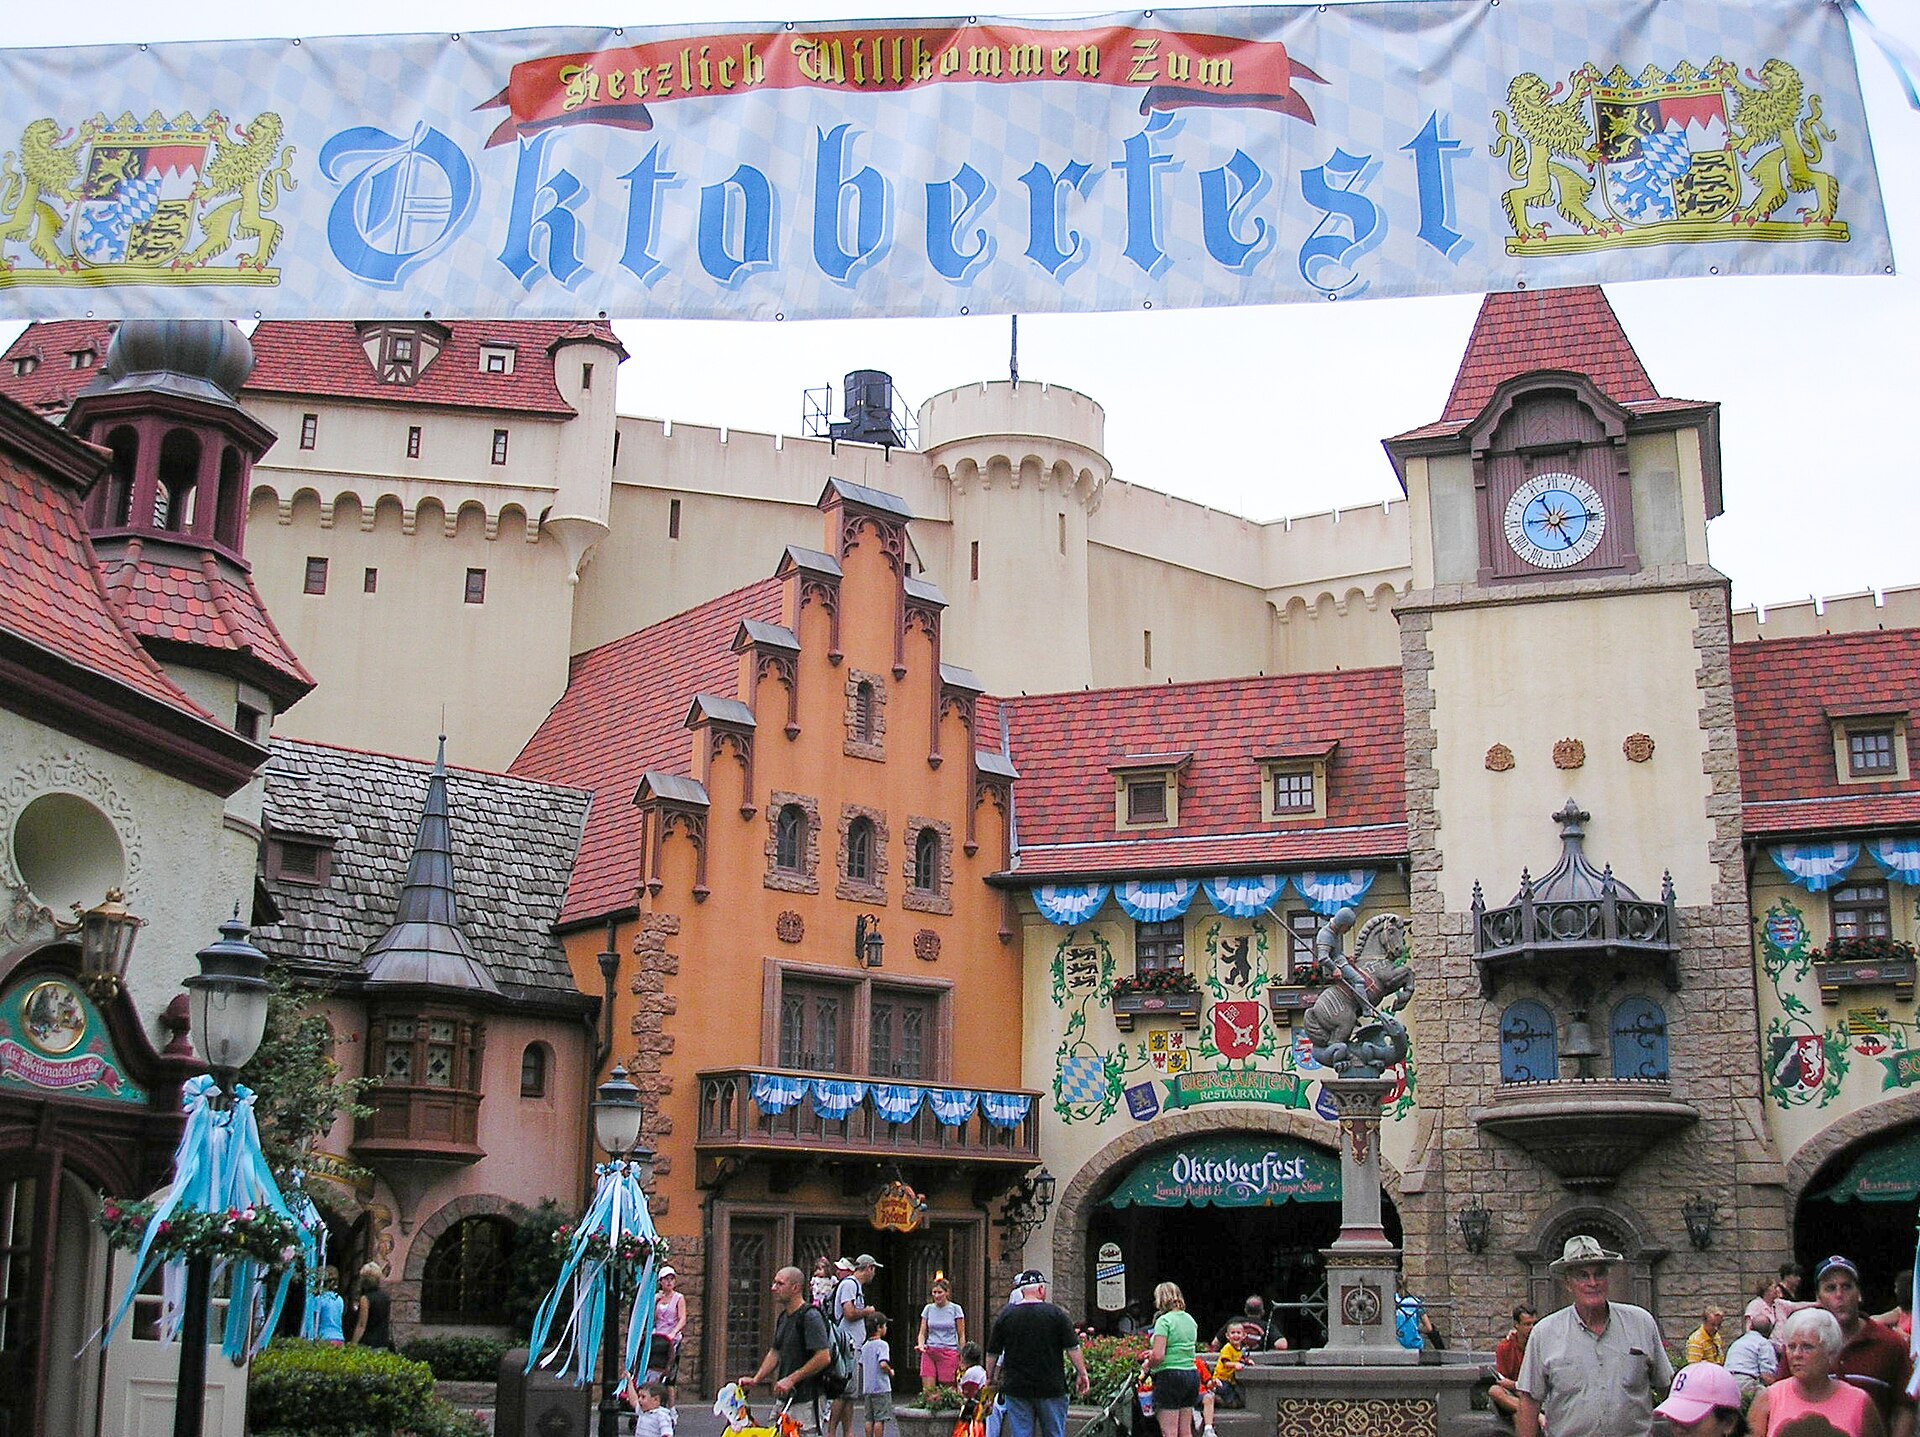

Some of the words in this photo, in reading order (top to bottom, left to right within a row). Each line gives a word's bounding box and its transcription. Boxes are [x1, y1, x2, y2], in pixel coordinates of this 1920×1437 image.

[559, 40, 765, 112] Herzlich
[790, 37, 1100, 86] Willkommen
[1126, 38, 1234, 87] Zum
[318, 109, 1475, 298] Oktoberfest
[1181, 1071, 1295, 1091] BIERGARTEN
[1201, 1088, 1271, 1101] RESTAURANT
[1172, 1151, 1305, 1192] Oktoberfest
[1673, 1372, 1687, 1392] B
